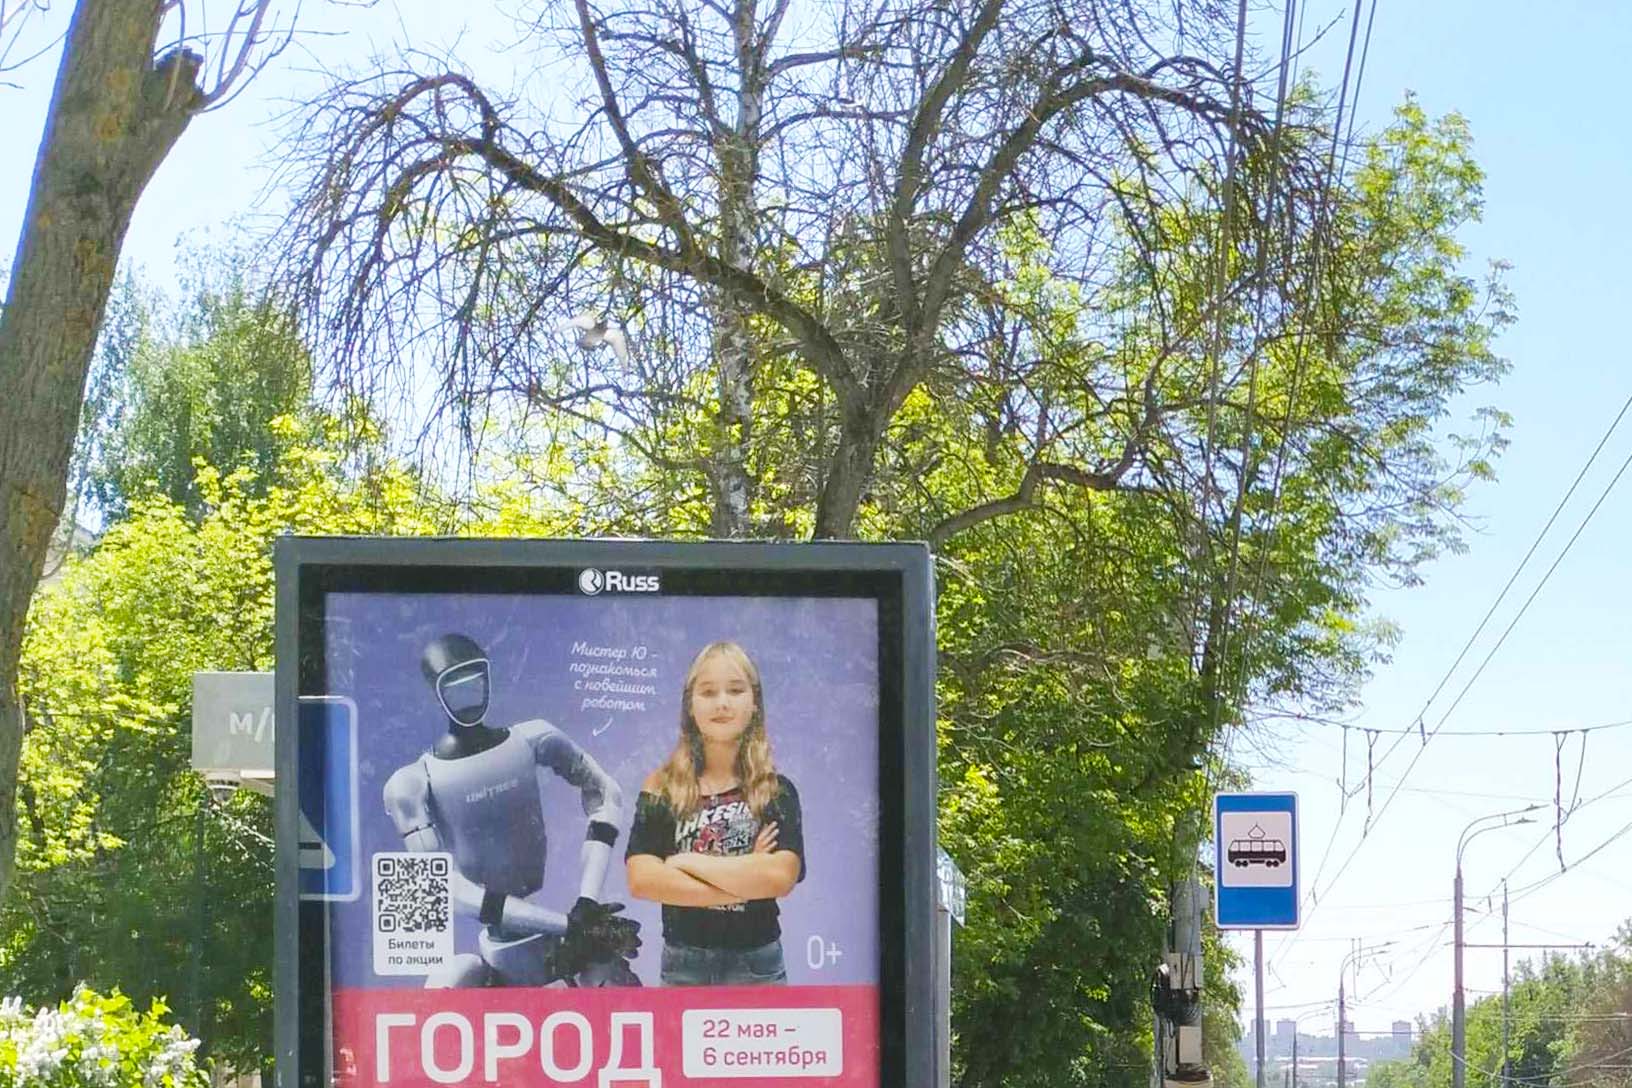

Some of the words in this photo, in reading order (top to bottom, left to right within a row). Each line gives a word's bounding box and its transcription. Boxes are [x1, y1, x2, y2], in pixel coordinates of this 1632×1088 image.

[605, 571, 660, 592] Russ
[571, 641, 627, 662] Мистер
[631, 645, 648, 660] Ю
[569, 662, 657, 678] познакомься
[584, 678, 657, 695] новейшим
[581, 695, 646, 712] роботом
[388, 938, 435, 950] Билеты
[807, 935, 843, 969] 0+
[388, 955, 403, 965] по
[406, 955, 443, 967] акции
[703, 1019, 731, 1038] 22
[737, 1023, 778, 1038] мая
[703, 1047, 717, 1066] 6
[724, 1046, 827, 1070] сентября
